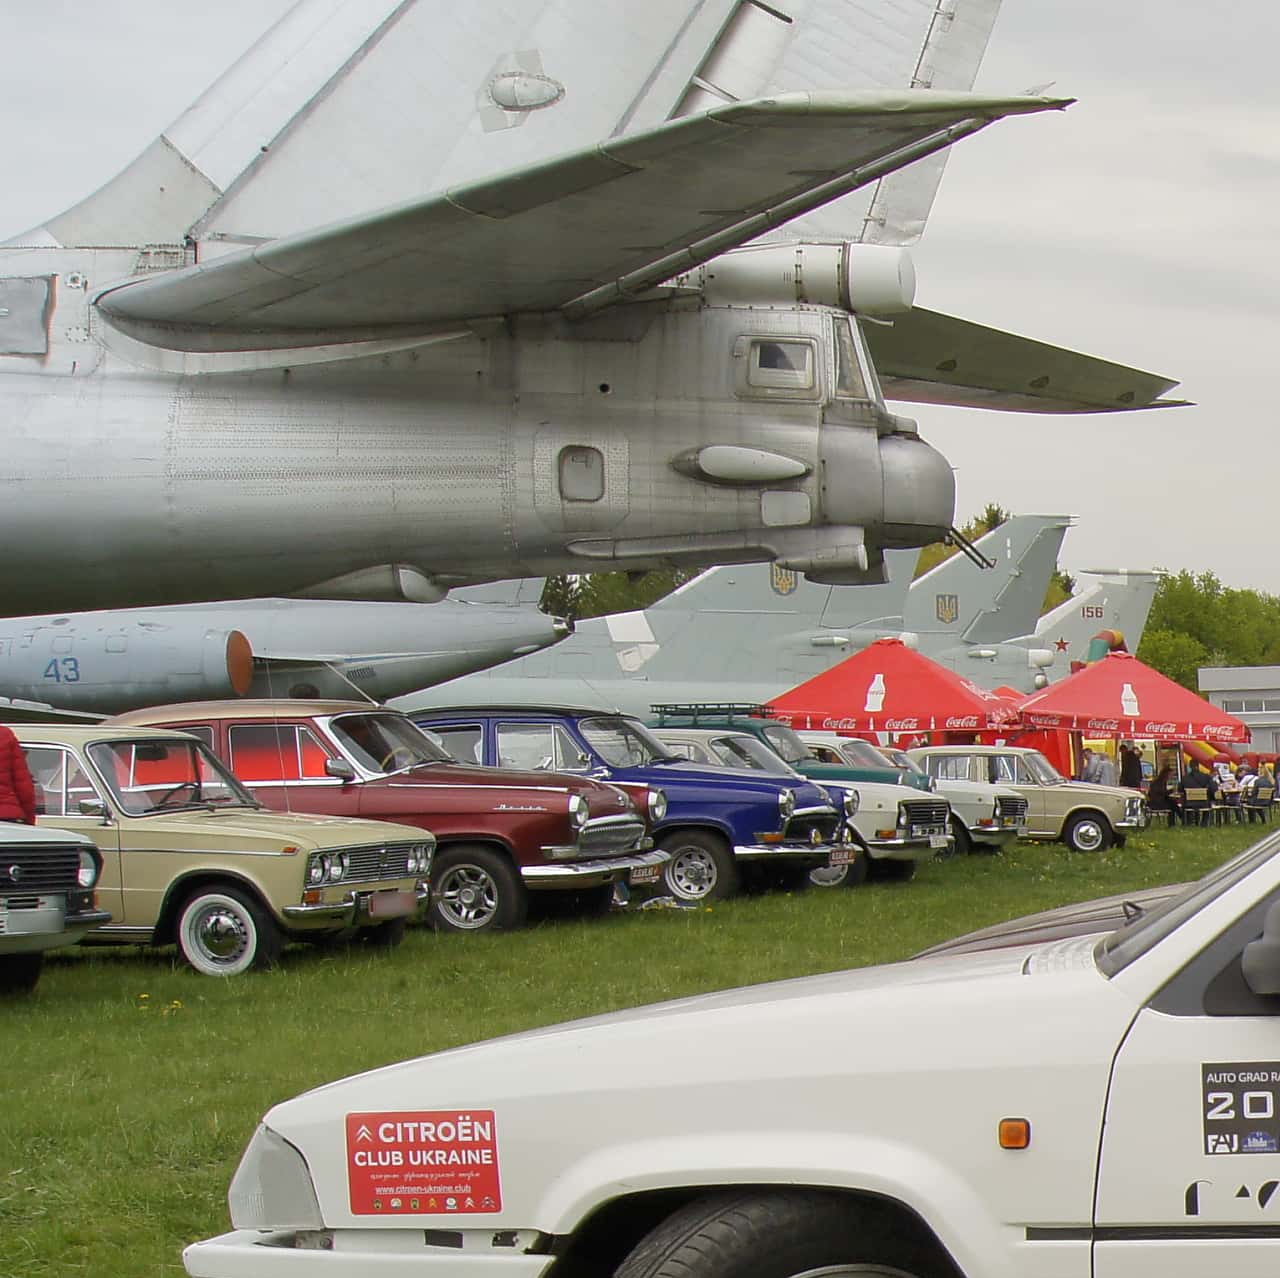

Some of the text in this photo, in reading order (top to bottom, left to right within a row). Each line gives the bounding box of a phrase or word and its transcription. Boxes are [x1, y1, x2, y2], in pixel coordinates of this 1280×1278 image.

[1082, 606, 1104, 618] 156
[43, 658, 80, 682] 43
[1207, 1072, 1236, 1083] AUTO
[1238, 1071, 1269, 1083] GRAD
[378, 1115, 492, 1143] CITROËN
[354, 1150, 493, 1166] CLUB UKRAINE
